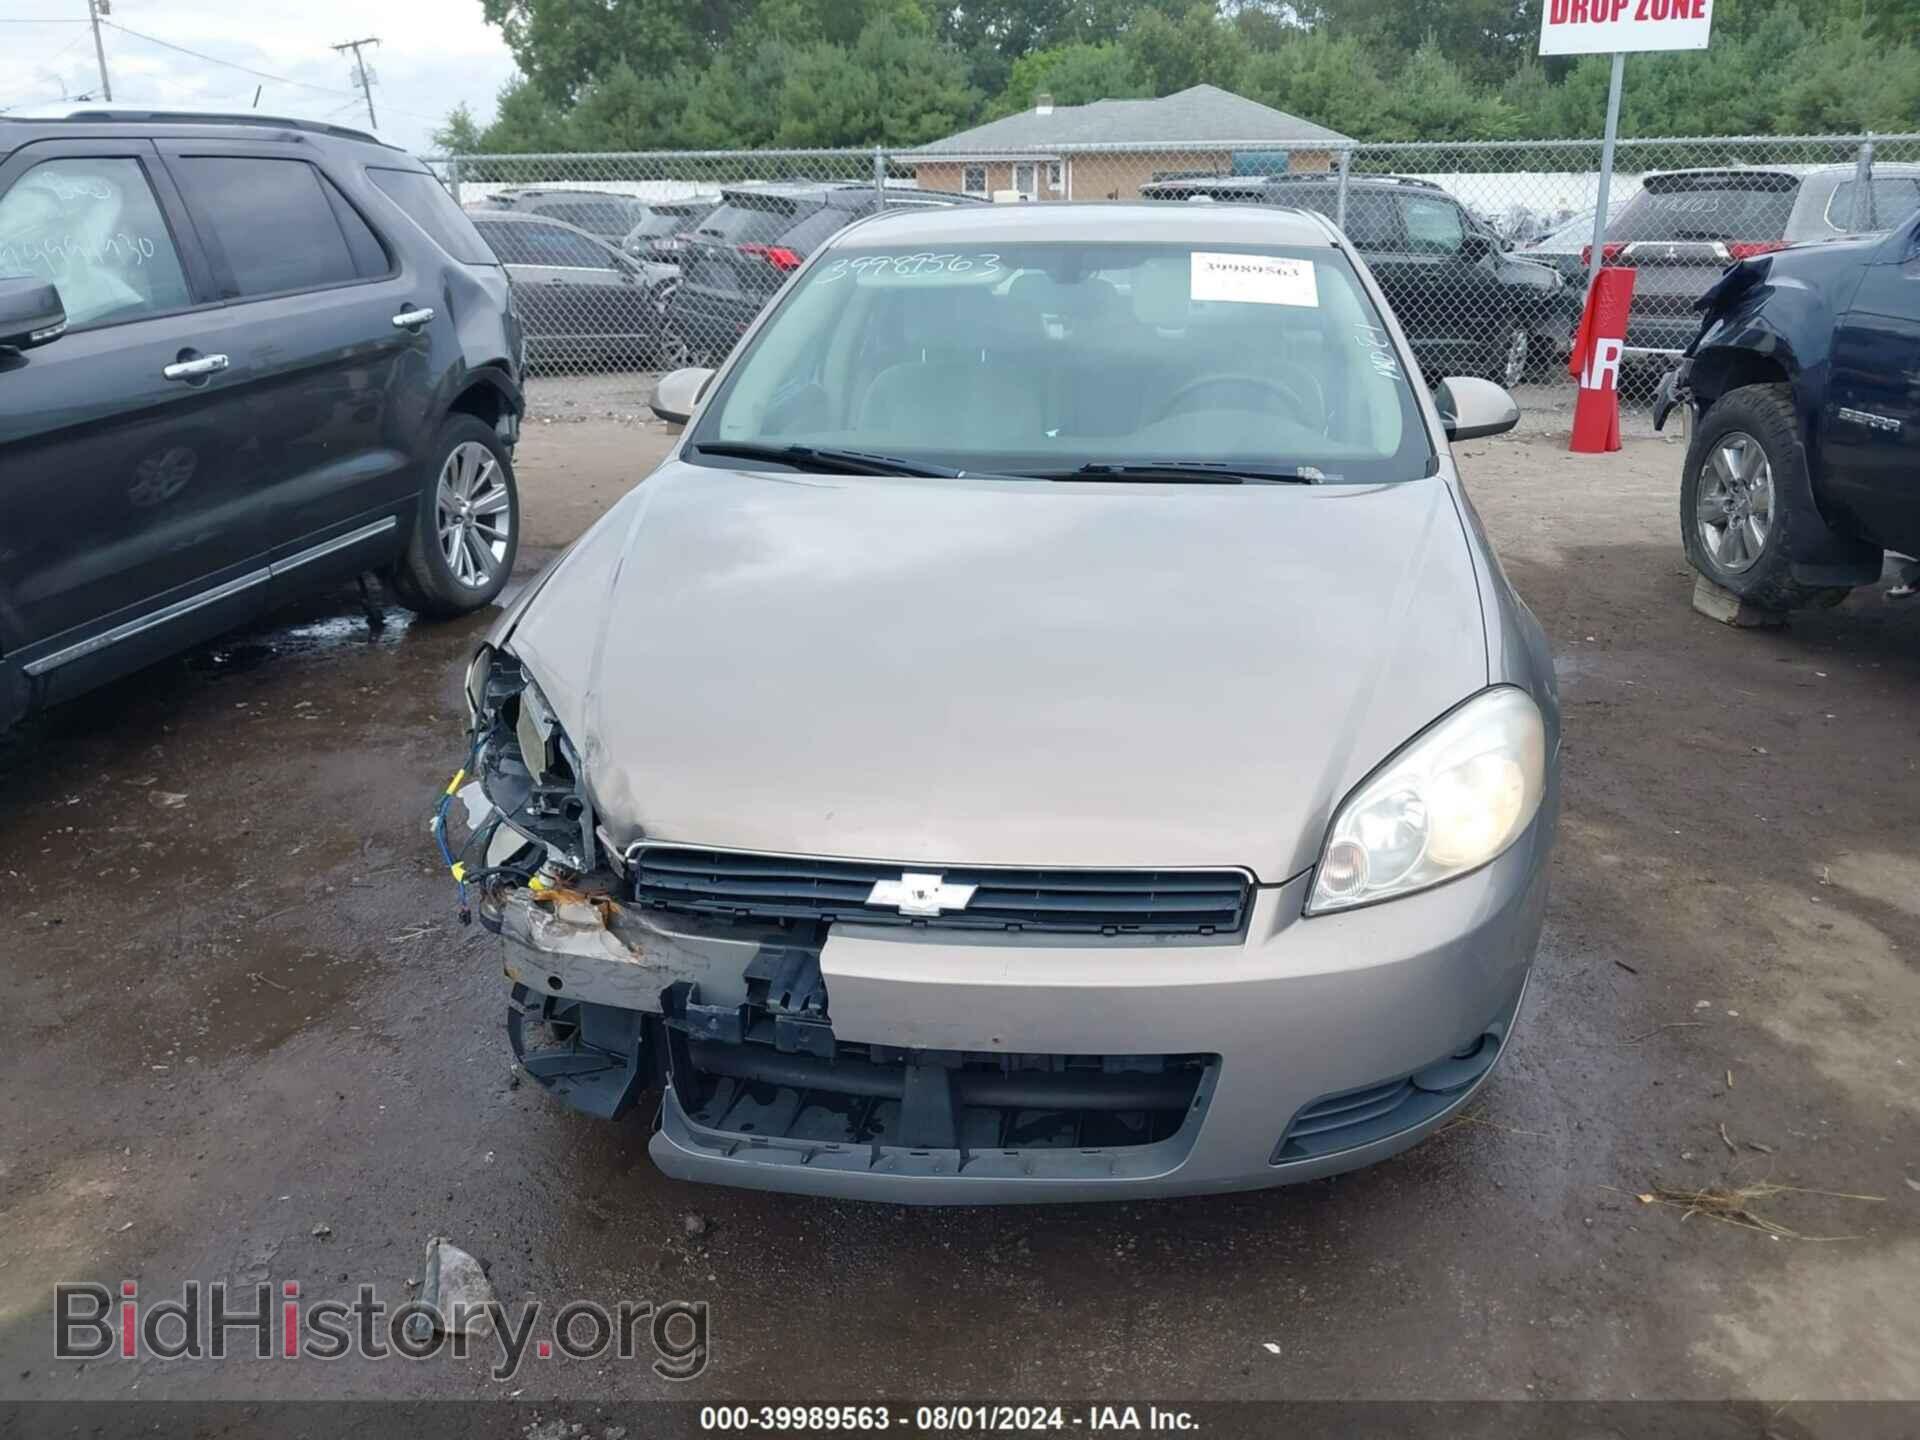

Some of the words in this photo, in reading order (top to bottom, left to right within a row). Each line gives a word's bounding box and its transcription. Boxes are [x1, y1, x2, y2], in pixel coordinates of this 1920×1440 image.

[1549, 0, 1629, 25] DROP
[1634, 0, 1706, 21] ZONE
[815, 252, 1000, 284] 39989563
